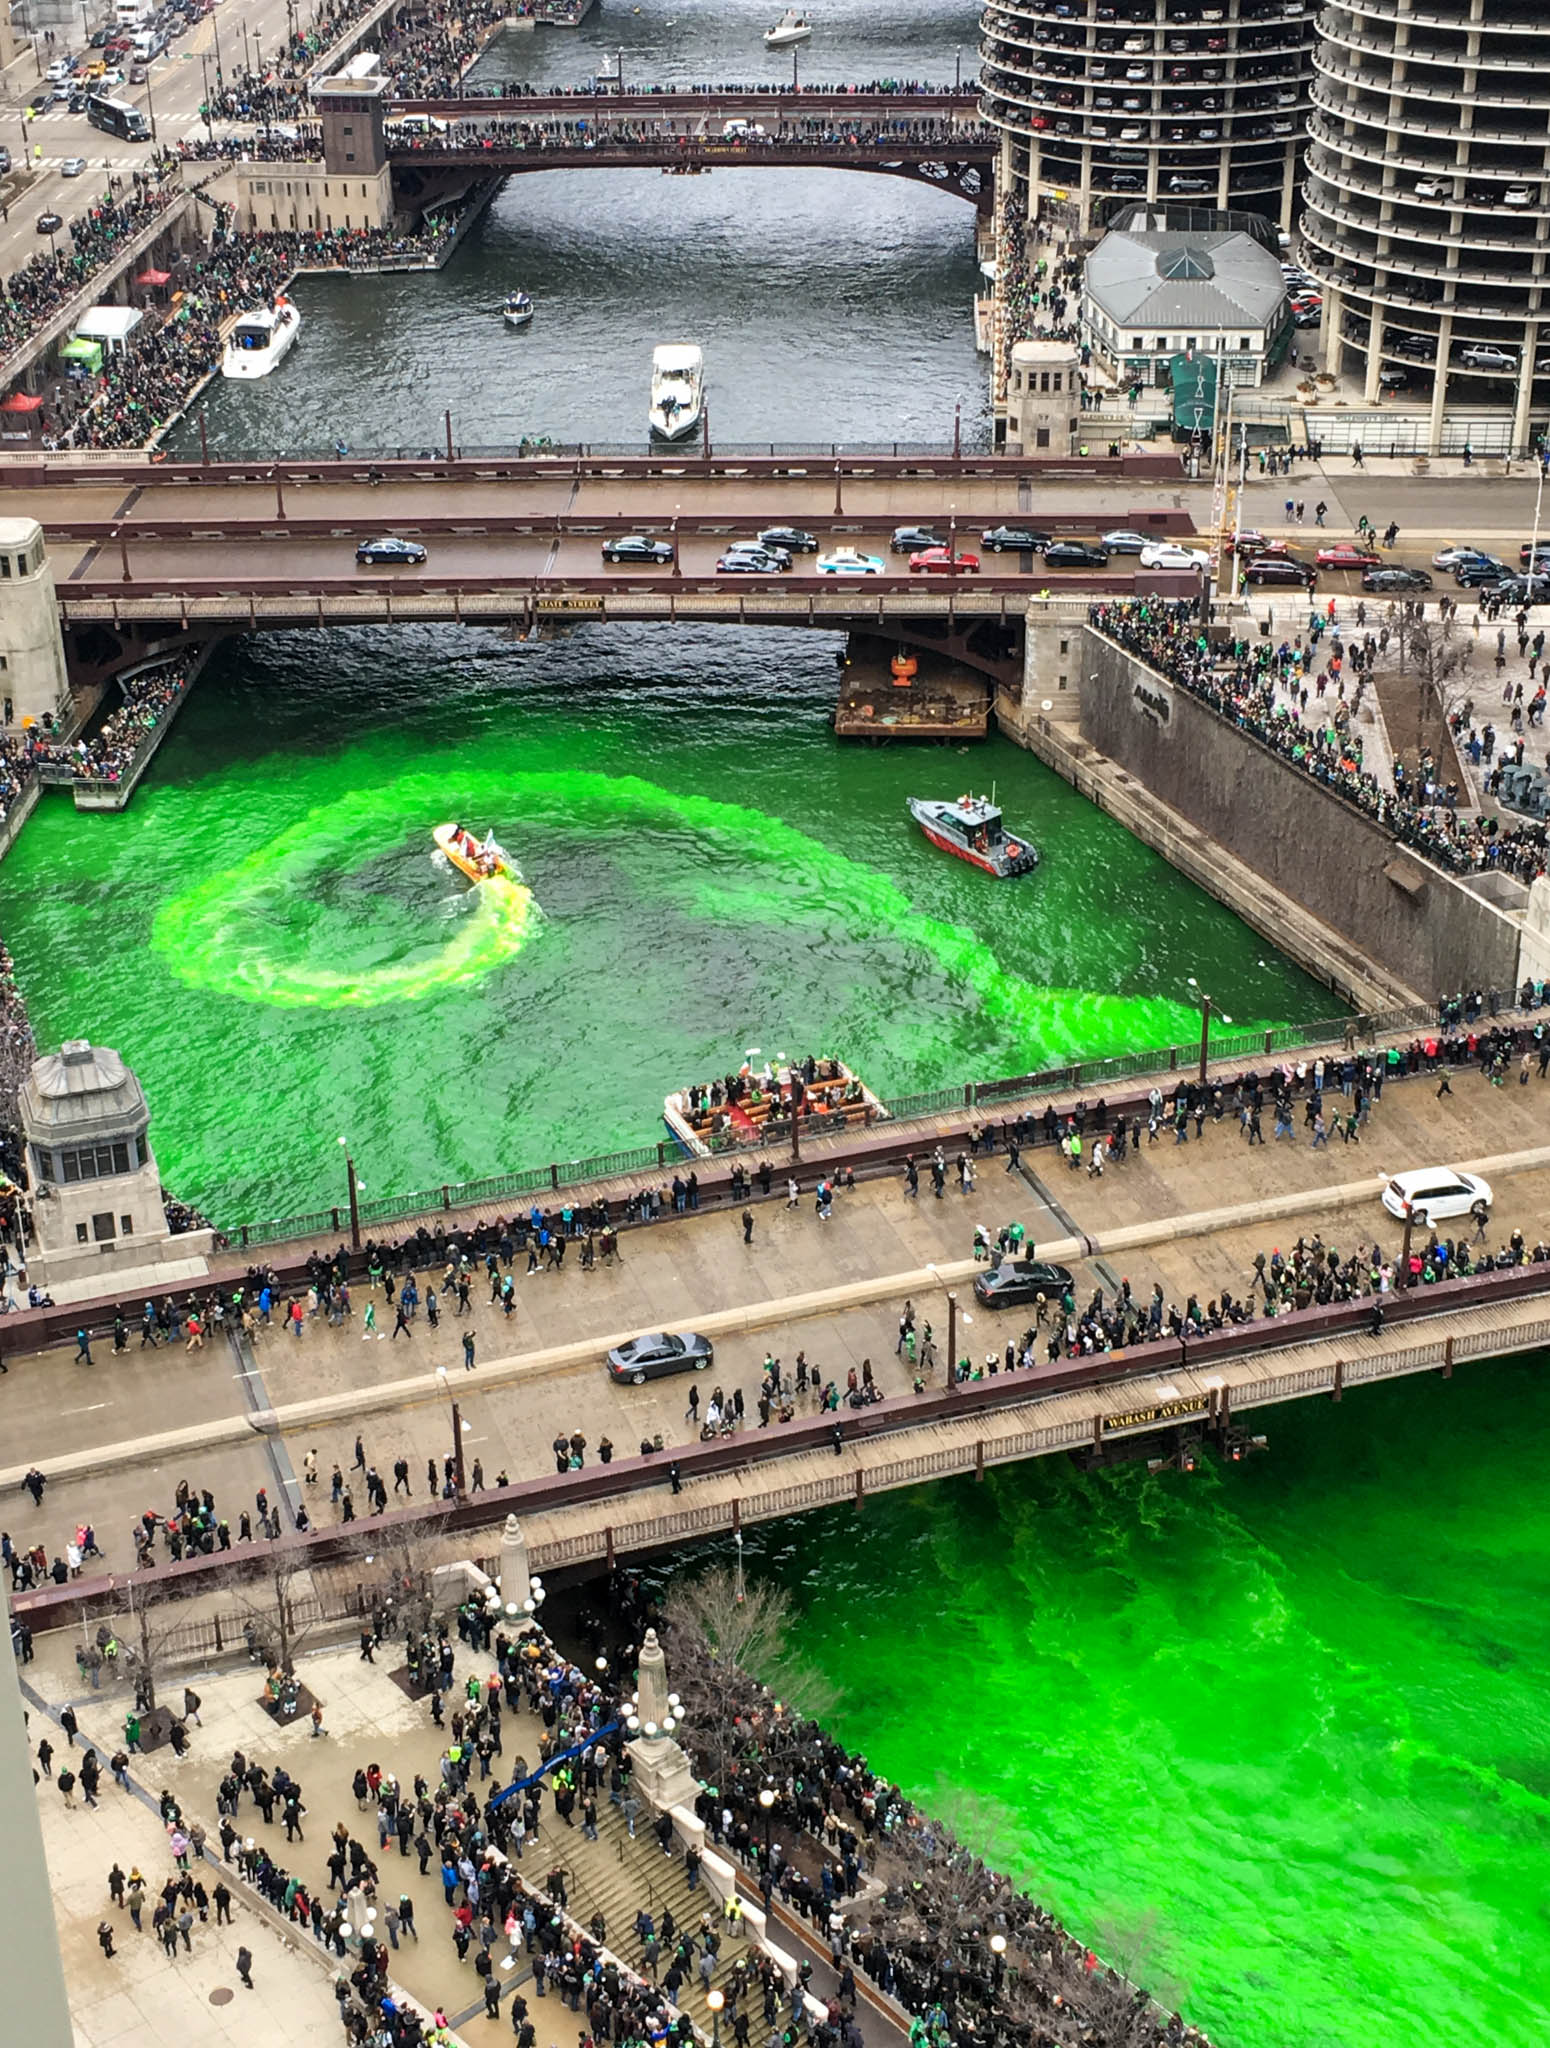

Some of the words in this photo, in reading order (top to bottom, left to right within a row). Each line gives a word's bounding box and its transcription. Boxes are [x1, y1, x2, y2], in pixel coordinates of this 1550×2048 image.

[539, 600, 562, 608] STATE
[567, 600, 600, 608] STREET
[1108, 1410, 1155, 1428] WABASH
[1160, 1400, 1206, 1417] AVENUE
